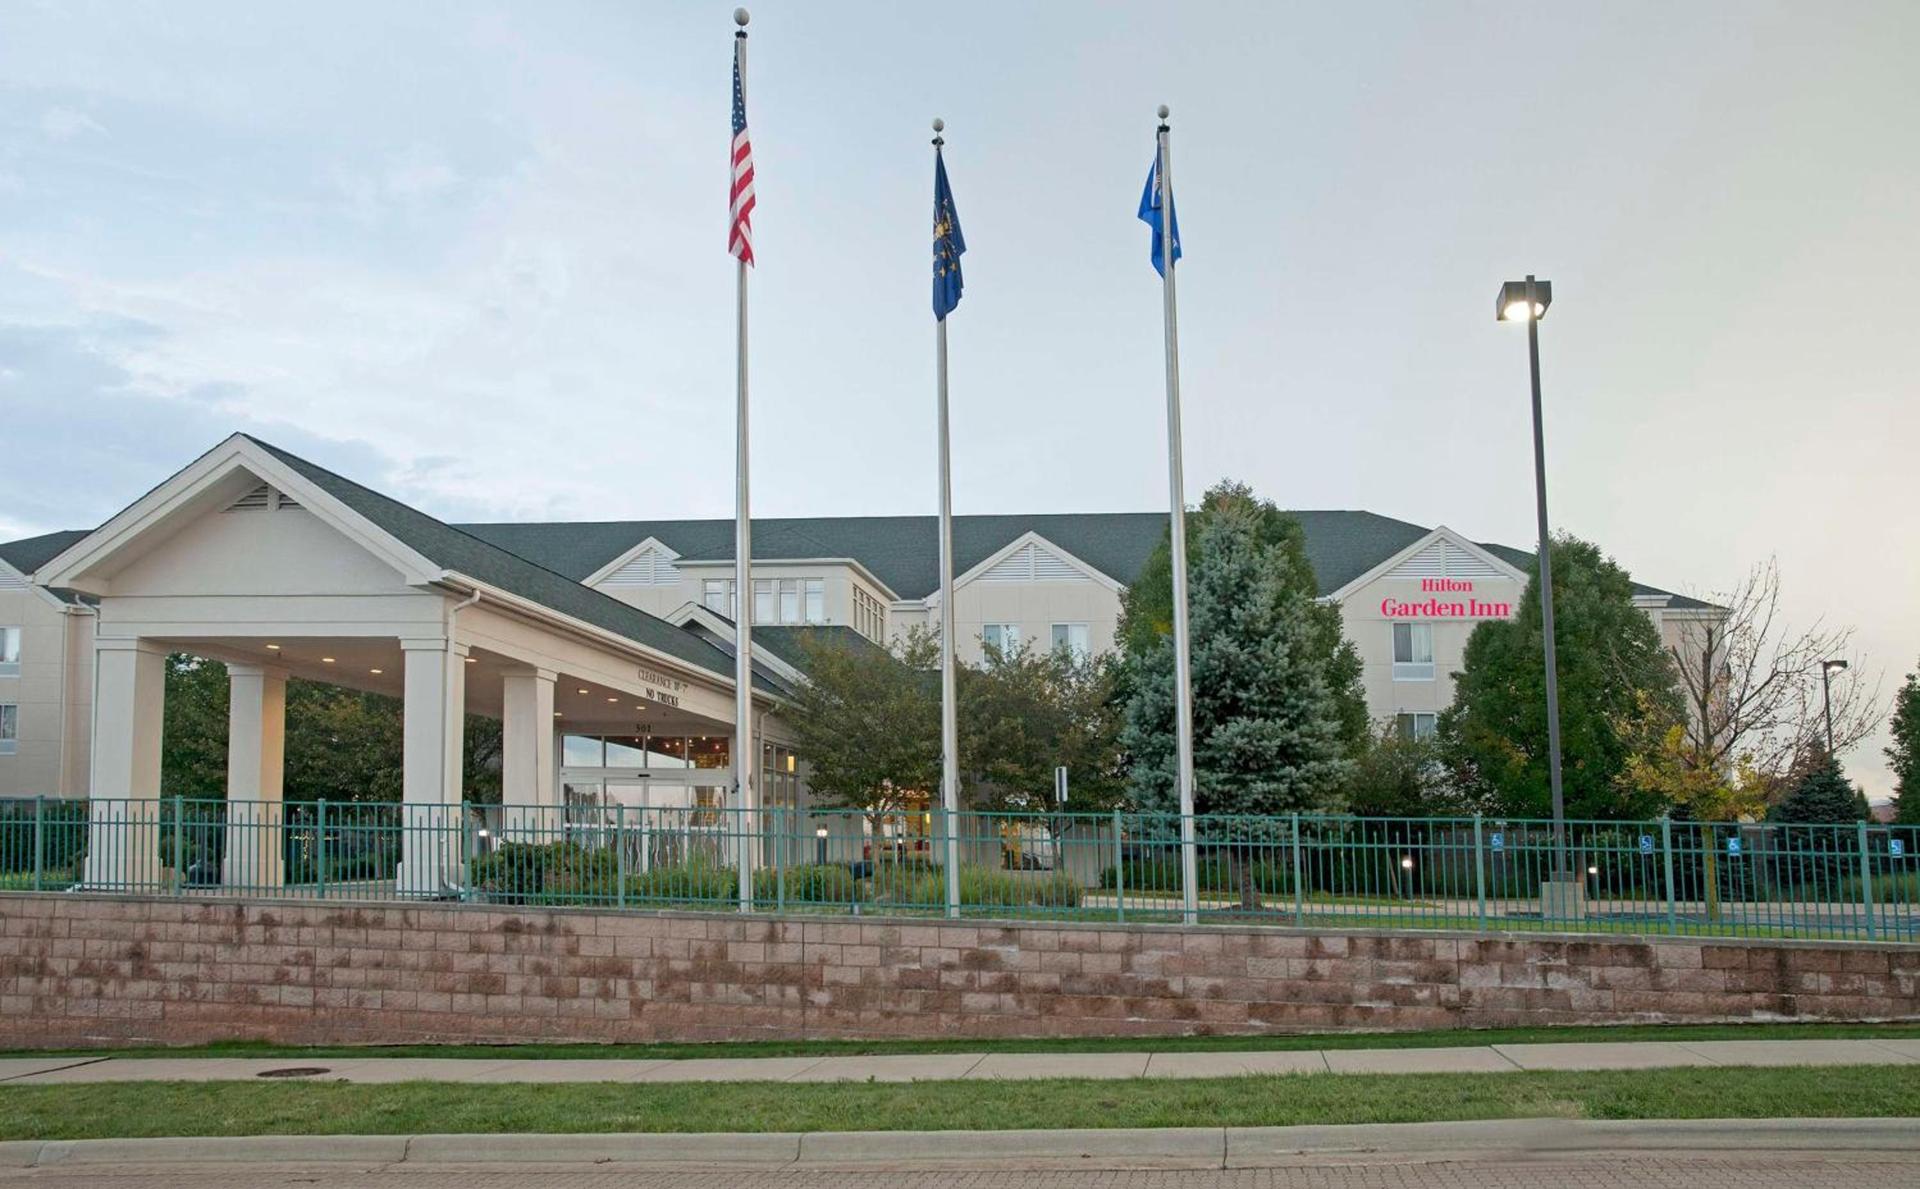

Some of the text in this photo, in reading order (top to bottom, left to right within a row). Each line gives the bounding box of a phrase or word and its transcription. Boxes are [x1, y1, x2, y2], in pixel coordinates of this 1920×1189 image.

[1421, 578, 1473, 592] Hilton
[1381, 598, 1511, 617] Garden Inn
[645, 687, 678, 706] NO TRUCKS
